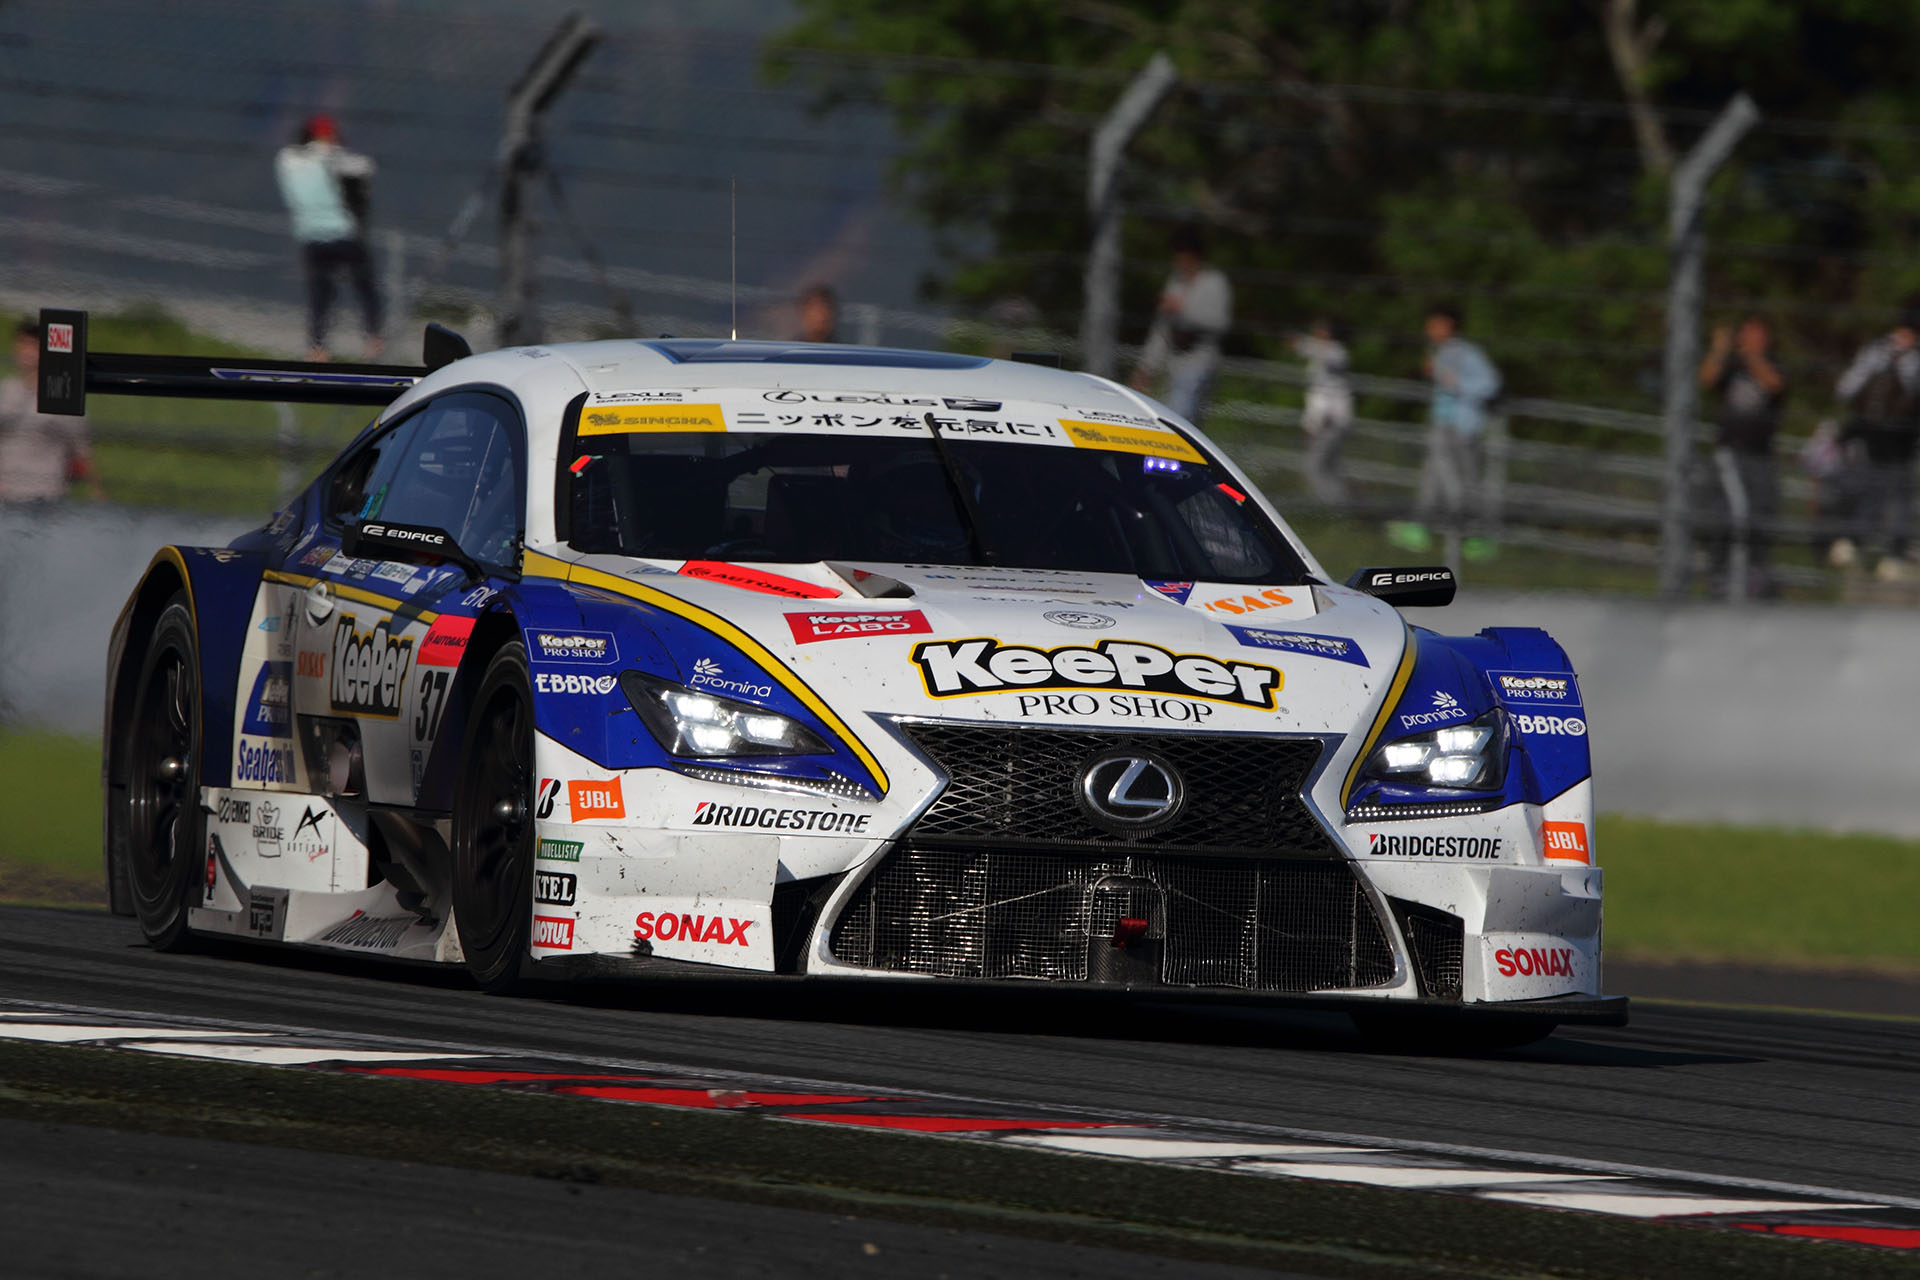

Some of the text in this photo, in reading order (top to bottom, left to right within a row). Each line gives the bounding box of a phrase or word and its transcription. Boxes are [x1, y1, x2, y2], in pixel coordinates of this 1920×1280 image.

[812, 394, 938, 407] LEXUS
[623, 416, 713, 426] SINGHA
[386, 529, 445, 545] EDIFICE
[1395, 572, 1452, 584] EDIFICE
[806, 614, 908, 625] KeePer
[812, 621, 912, 636] LABO
[538, 634, 606, 649] KeePer
[1244, 629, 1348, 651] KeePer
[330, 613, 414, 712] KeePer
[543, 648, 606, 659] PRO SHOP
[535, 672, 618, 695] EBBRO
[914, 640, 1278, 708] KeePer
[1500, 674, 1568, 690] KeePer
[690, 673, 772, 698] promina
[1506, 688, 1567, 700] PRO SHOP
[415, 670, 450, 742] 37
[1019, 695, 1213, 724] PRO SHOP
[1400, 705, 1467, 730] promina
[577, 788, 619, 809] JBL
[692, 802, 872, 833] BRIDGESTONE
[252, 824, 285, 840] BRIDE
[1545, 830, 1585, 852] JBL
[1370, 833, 1502, 859] BRIDGESTONE
[534, 920, 571, 945] MOTUL
[633, 912, 754, 947] SONAX
[1494, 948, 1575, 978] SONAX
